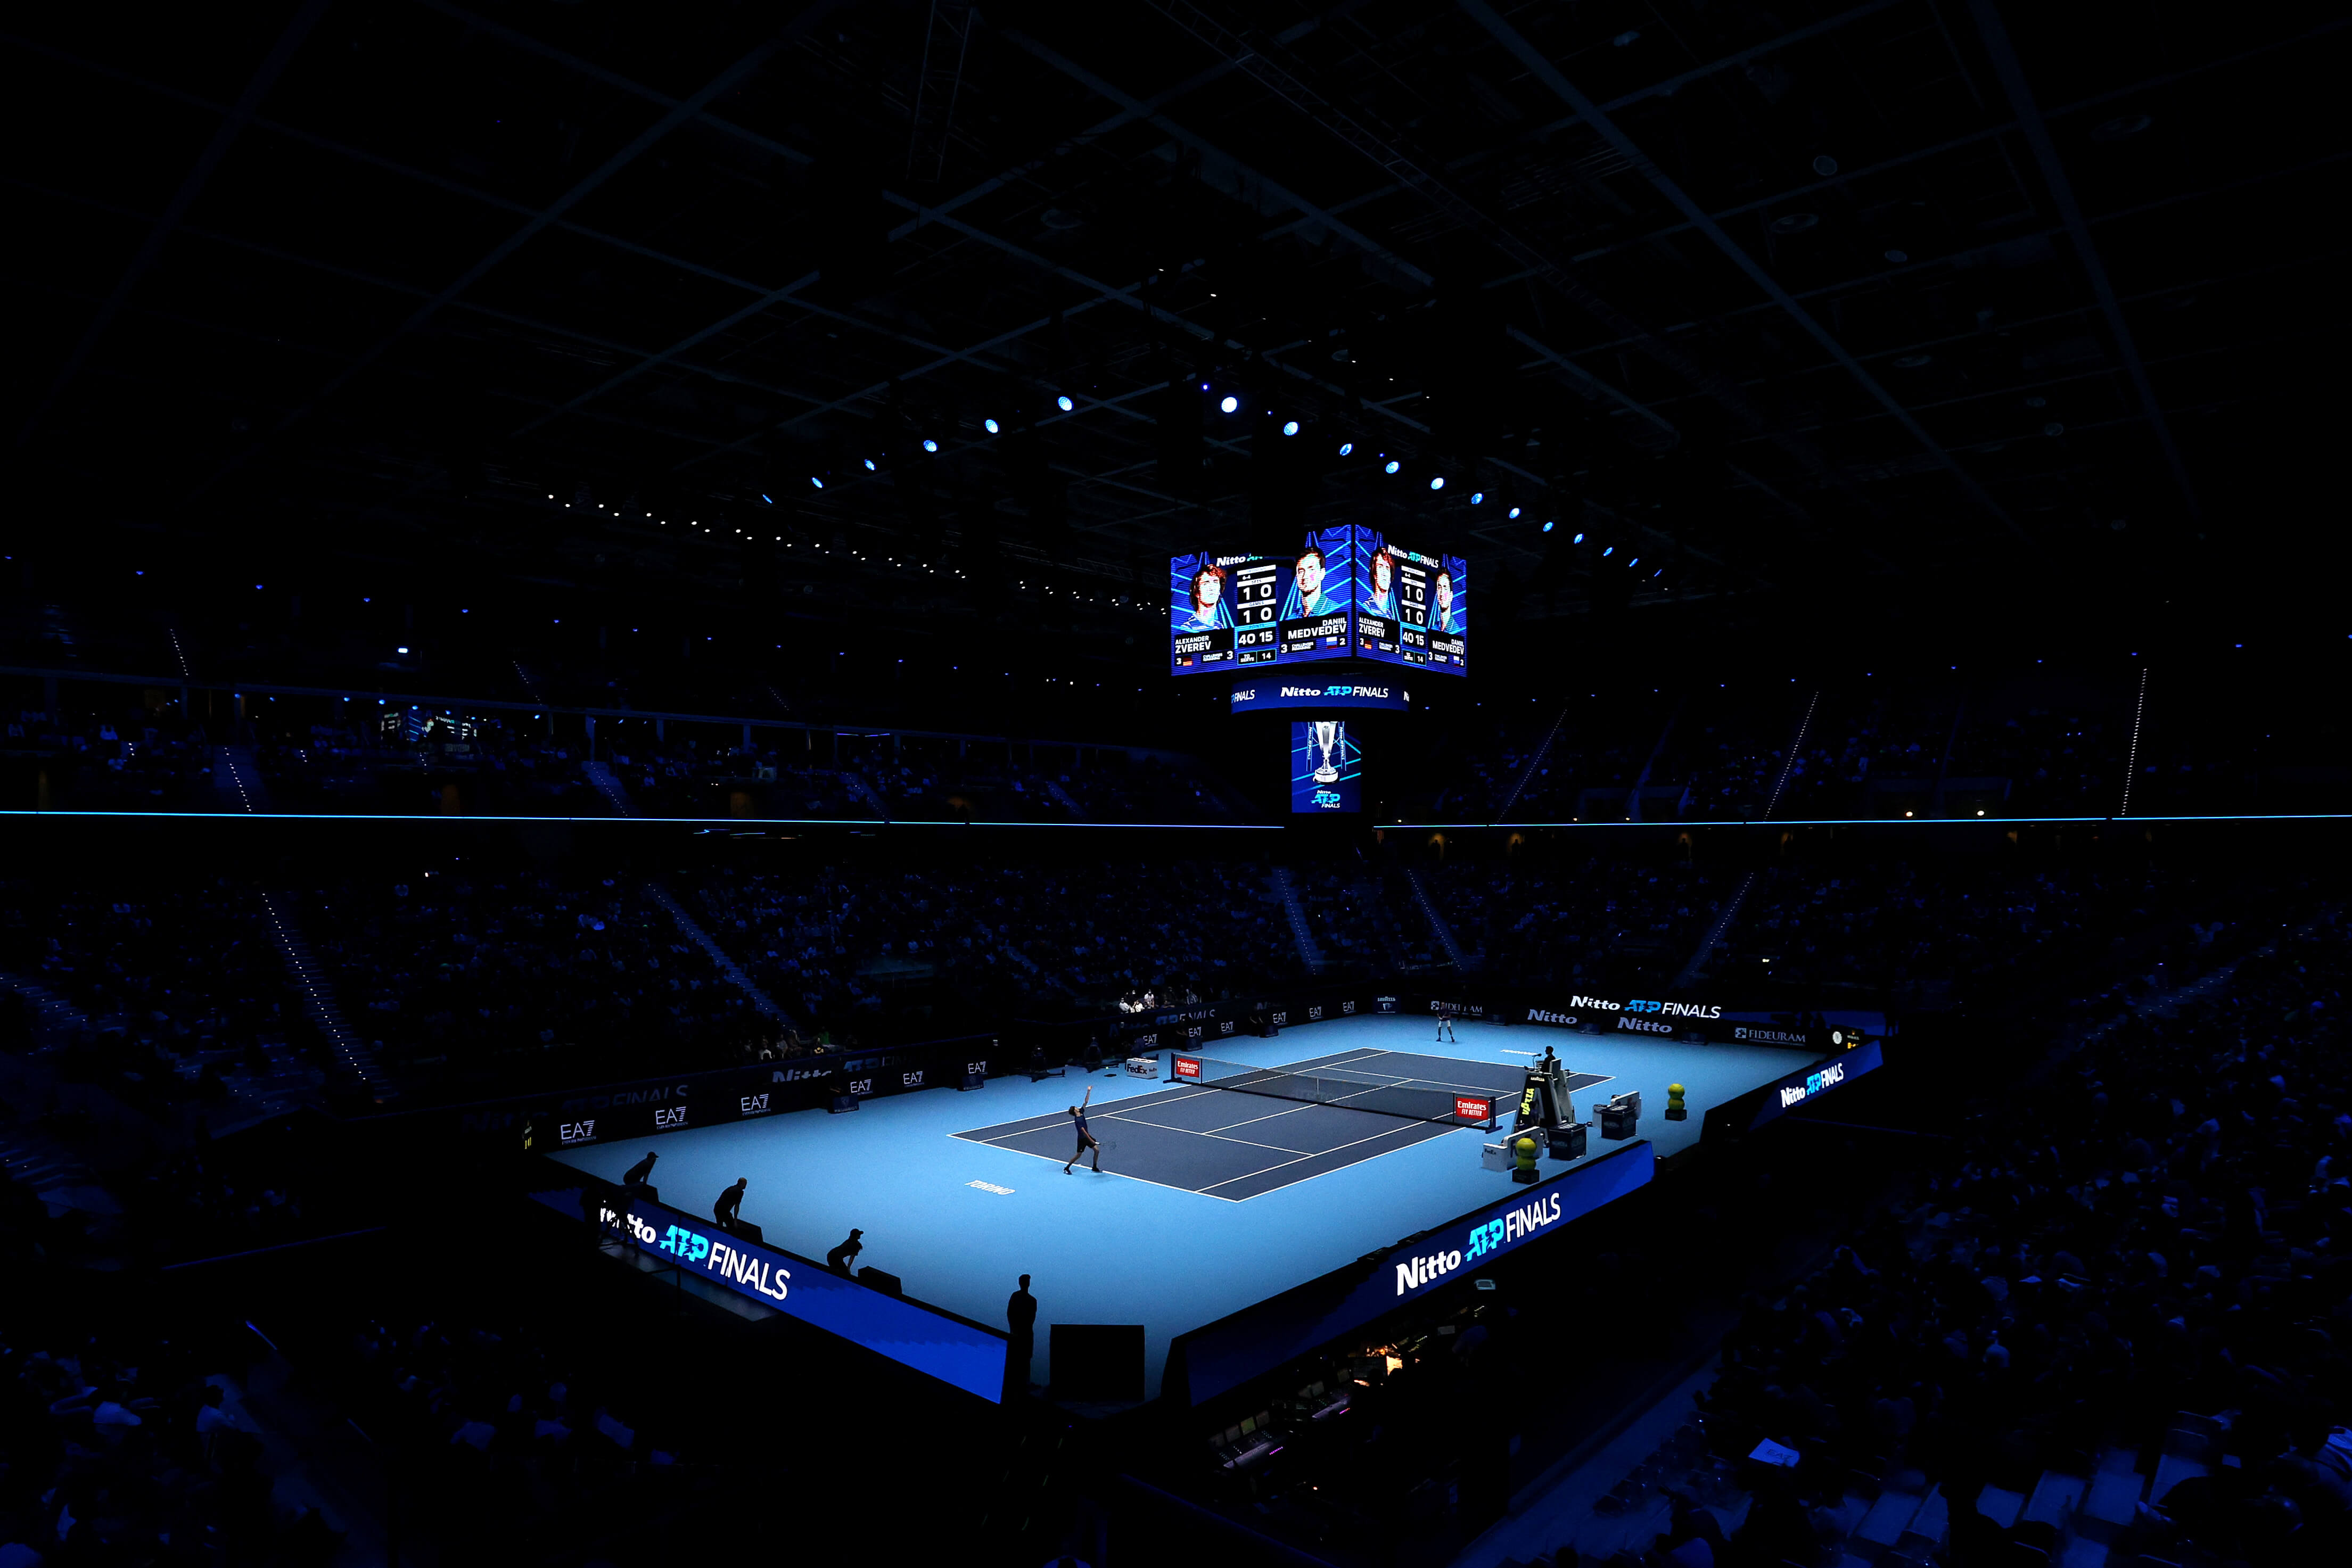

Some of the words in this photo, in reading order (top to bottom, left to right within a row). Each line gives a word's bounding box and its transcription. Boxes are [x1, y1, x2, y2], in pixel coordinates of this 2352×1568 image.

[1216, 556, 1246, 567] Nitto
[1388, 544, 1407, 558] Nitto
[1408, 551, 1420, 562] ATP
[1420, 555, 1438, 568] FINALS
[1244, 587, 1249, 600] 1
[1261, 584, 1272, 597] 0
[1405, 585, 1410, 599] 1
[1416, 589, 1423, 601] 0
[1244, 610, 1249, 623] 1
[1261, 607, 1272, 621] 0
[1322, 617, 1347, 626] DANIIL
[1405, 609, 1410, 622] 1
[1416, 611, 1424, 624] 0
[1359, 617, 1384, 628] ALEXANDER
[1288, 624, 1346, 639] MEDVEDEV
[1359, 624, 1385, 638] ZVEREV
[1175, 636, 1209, 645] ALEXANDER
[1239, 633, 1255, 645] 40
[1260, 631, 1273, 642] 15
[1403, 632, 1413, 643] 40
[1416, 634, 1424, 646] 15
[1175, 641, 1211, 654] ZVEREV
[1281, 644, 1288, 653] 3
[1395, 645, 1400, 654] 3
[1433, 640, 1465, 655] MEDVEDEV
[1227, 651, 1233, 659] 3
[1428, 652, 1433, 661] 3
[1234, 690, 1255, 703] FINALS
[1281, 687, 1320, 697] Nitto
[1323, 686, 1352, 696] ATP
[1353, 686, 1388, 698] FINALS
[1311, 794, 1341, 803] ATP
[1309, 1006, 1321, 1017] EA7
[1343, 1001, 1354, 1012] EA7
[1570, 995, 1621, 1011] Nitto
[1624, 1000, 1661, 1013] ATP
[1662, 1002, 1721, 1019] FINALS
[1273, 1012, 1286, 1024] EA7
[1527, 1009, 1577, 1024] Nitto
[1221, 1021, 1233, 1032] EA7
[1617, 1017, 1672, 1033] Nitto
[1189, 1027, 1201, 1037] EA7
[1749, 1030, 1806, 1043] FIDEURAM
[968, 1061, 986, 1074] EA7
[1126, 1063, 1147, 1075] FedEx
[1177, 1060, 1198, 1070] Emirates
[903, 1071, 923, 1085] EA7
[850, 1079, 871, 1093] EA7
[1780, 1087, 1805, 1108] Nitto
[1806, 1073, 1821, 1095] ATP
[1821, 1063, 1844, 1088] FINALS
[741, 1094, 769, 1111] EA7
[1458, 1101, 1486, 1111] Emirates
[655, 1106, 686, 1125] EA7
[561, 1120, 595, 1140] EA7
[1396, 1250, 1461, 1296] Nitto
[1464, 1218, 1504, 1262] ATP
[1506, 1193, 1561, 1243] FINALS
[659, 1225, 708, 1262] ATP
[708, 1242, 791, 1300] FINALS
